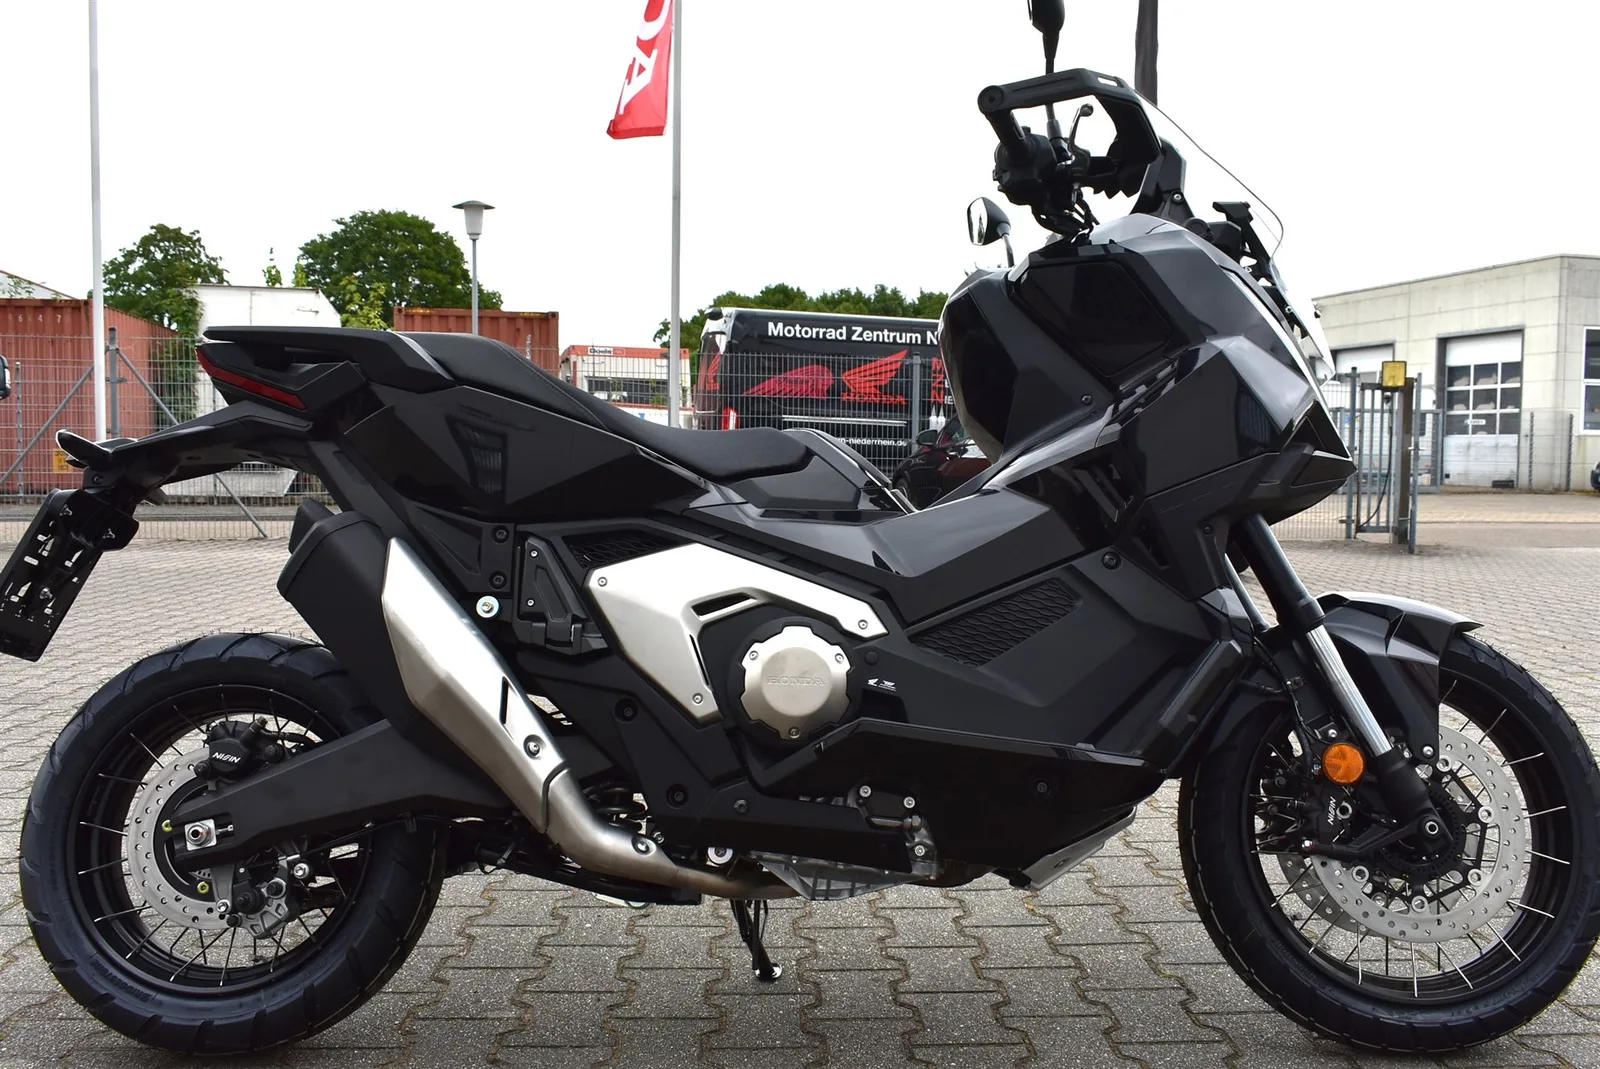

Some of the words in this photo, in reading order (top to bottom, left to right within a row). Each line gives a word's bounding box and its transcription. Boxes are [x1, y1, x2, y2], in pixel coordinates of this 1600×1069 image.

[767, 321, 847, 341] Motorrad
[851, 326, 922, 344] Zentrum
[842, 392, 908, 405] HONDA
[767, 675, 827, 687] HONDA
